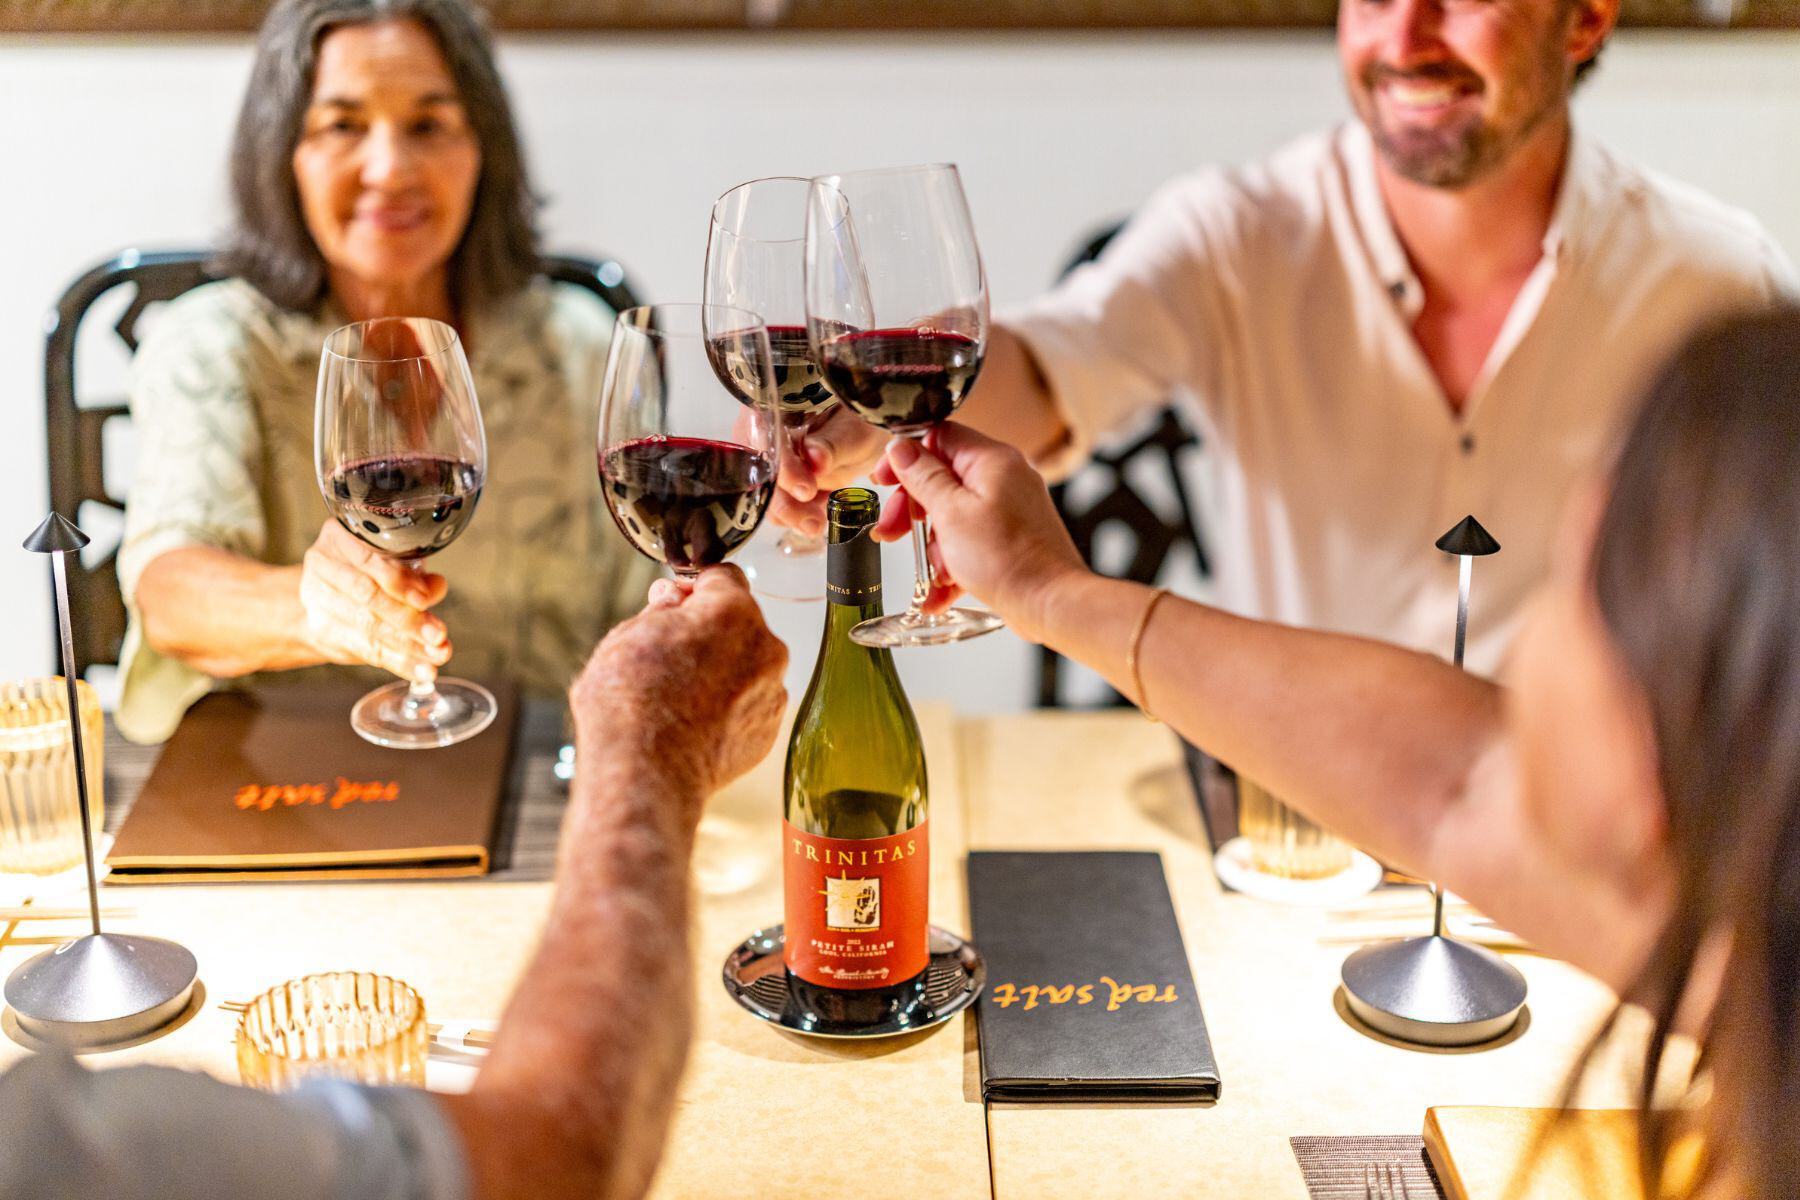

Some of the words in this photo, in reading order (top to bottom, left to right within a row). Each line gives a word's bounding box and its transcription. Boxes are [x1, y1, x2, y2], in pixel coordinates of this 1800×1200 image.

[793, 838, 916, 865] TRINITAS
[811, 938, 853, 952] PETITE
[859, 940, 895, 952] SIRAH
[992, 983, 1094, 1011] salt
[1100, 976, 1178, 1011] red
